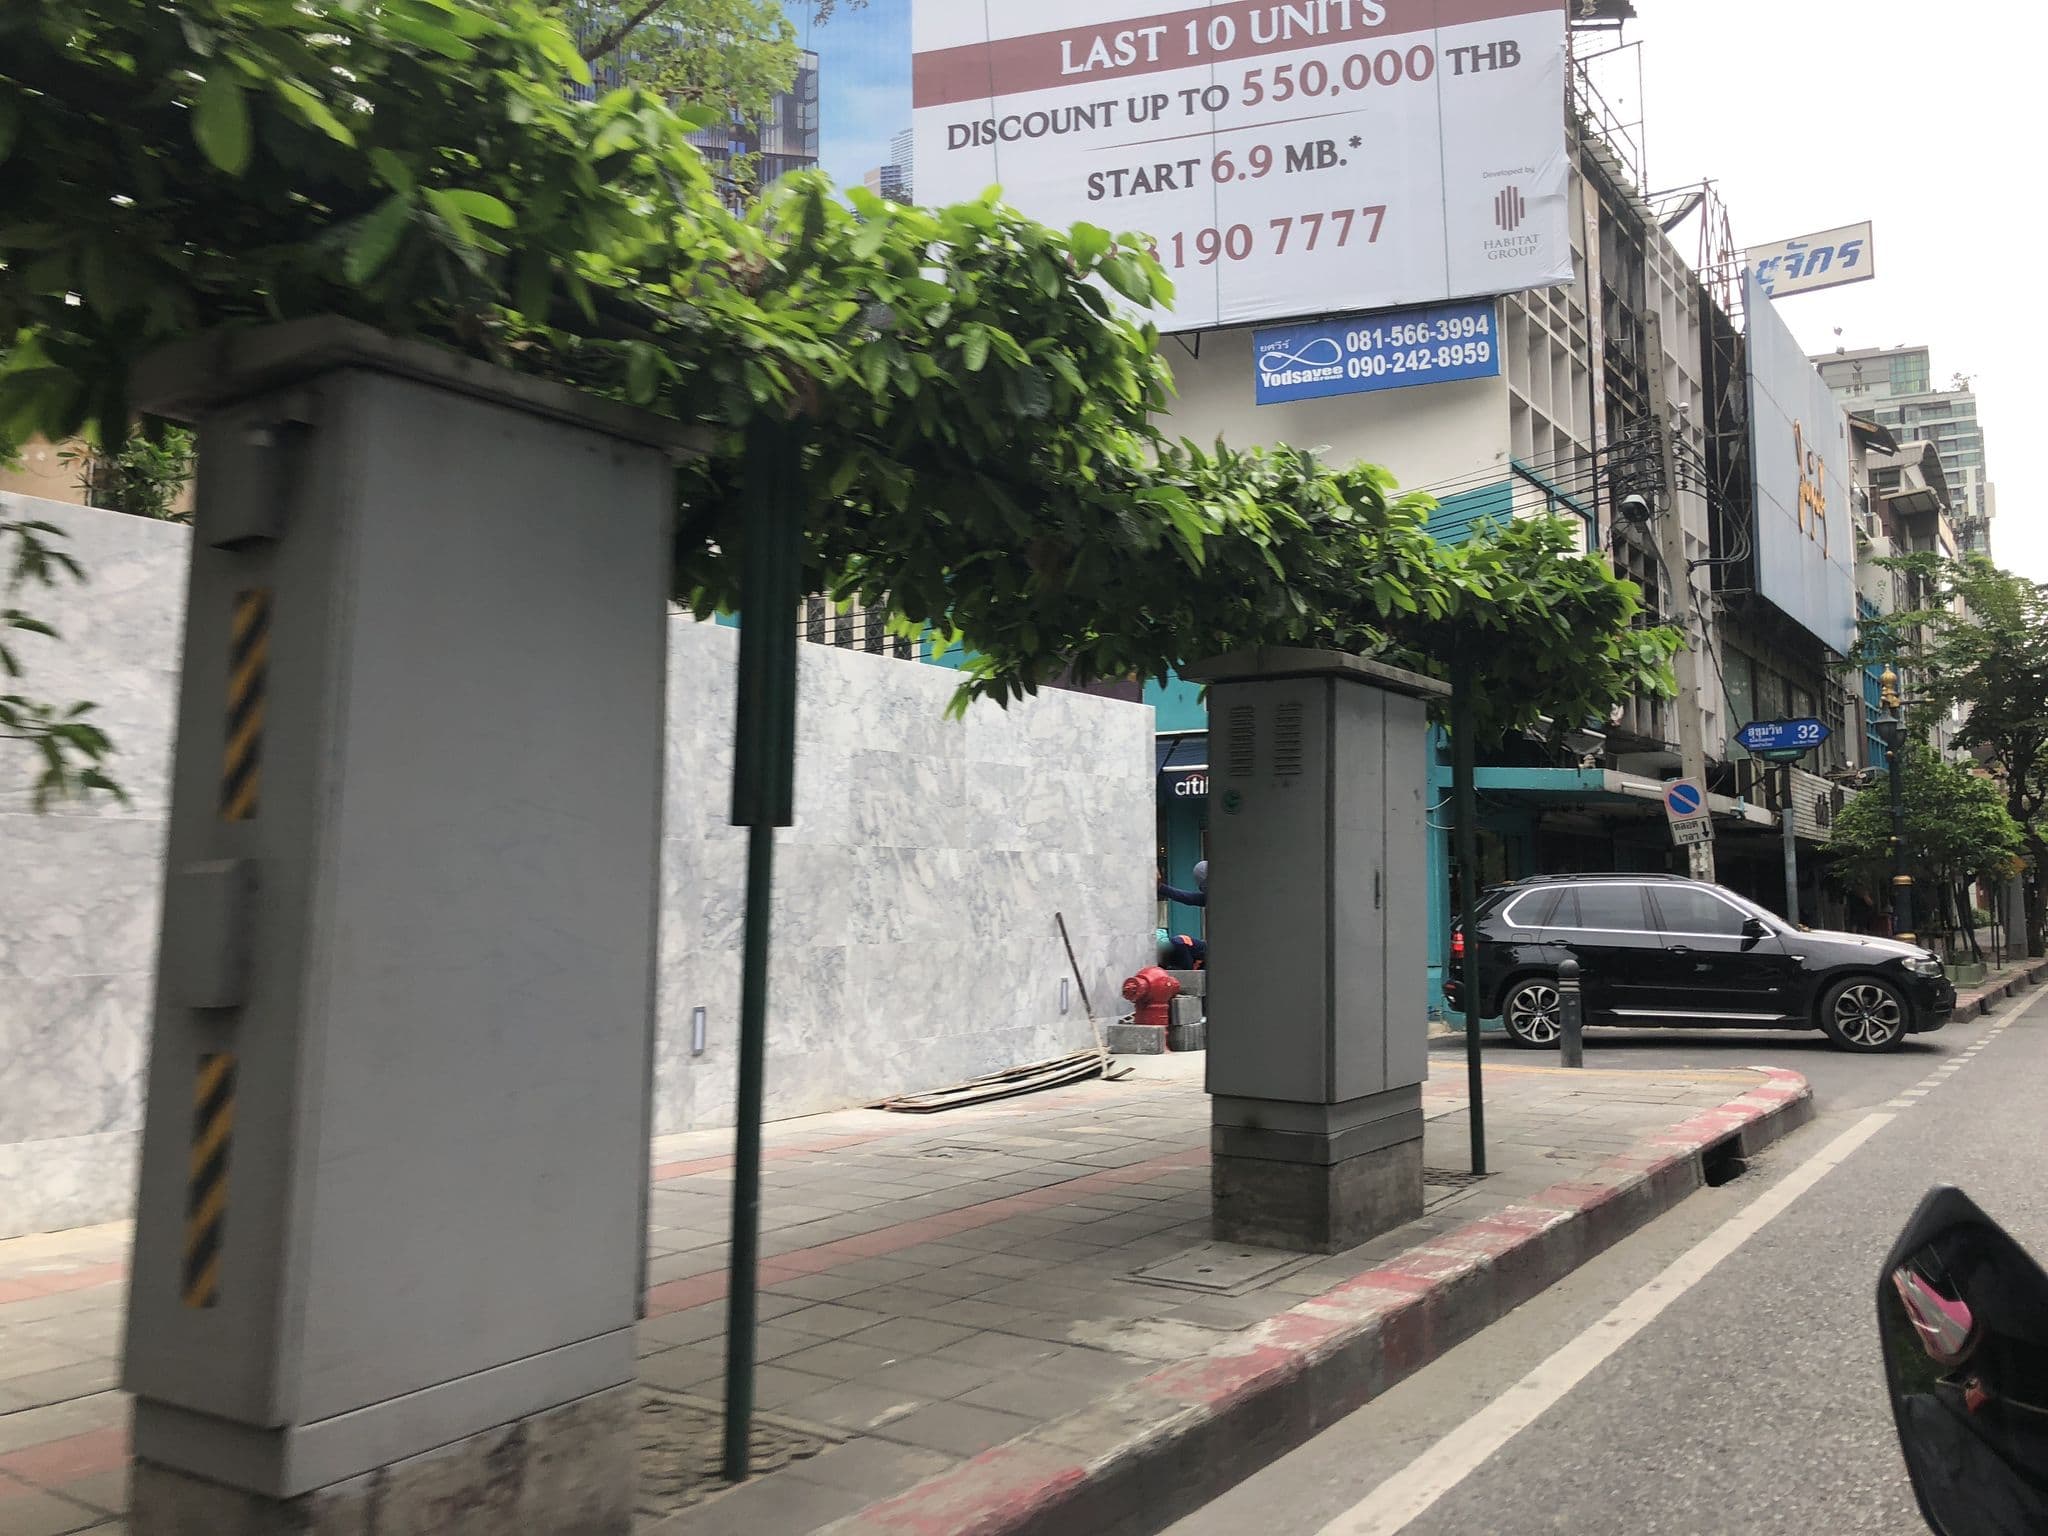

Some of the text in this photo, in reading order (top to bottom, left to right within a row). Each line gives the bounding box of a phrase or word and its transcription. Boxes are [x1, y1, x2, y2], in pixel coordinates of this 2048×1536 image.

[1061, 0, 1386, 74] LAST 10 UNITS
[948, 40, 1521, 150] DISCOUNT UP TO 550,000 THB
[1088, 159, 1201, 200] START
[1211, 144, 1273, 183] 6.9
[1483, 166, 1535, 178] Developed by
[1270, 205, 1387, 254] 7777
[1483, 234, 1540, 250] HABITAT
[1488, 246, 1536, 260] GROUP
[1346, 314, 1489, 352] 081-566-3994
[1260, 366, 1344, 388] Yodsavee
[1348, 341, 1490, 378] 090-242-8959
[1797, 724, 1819, 739] 32
